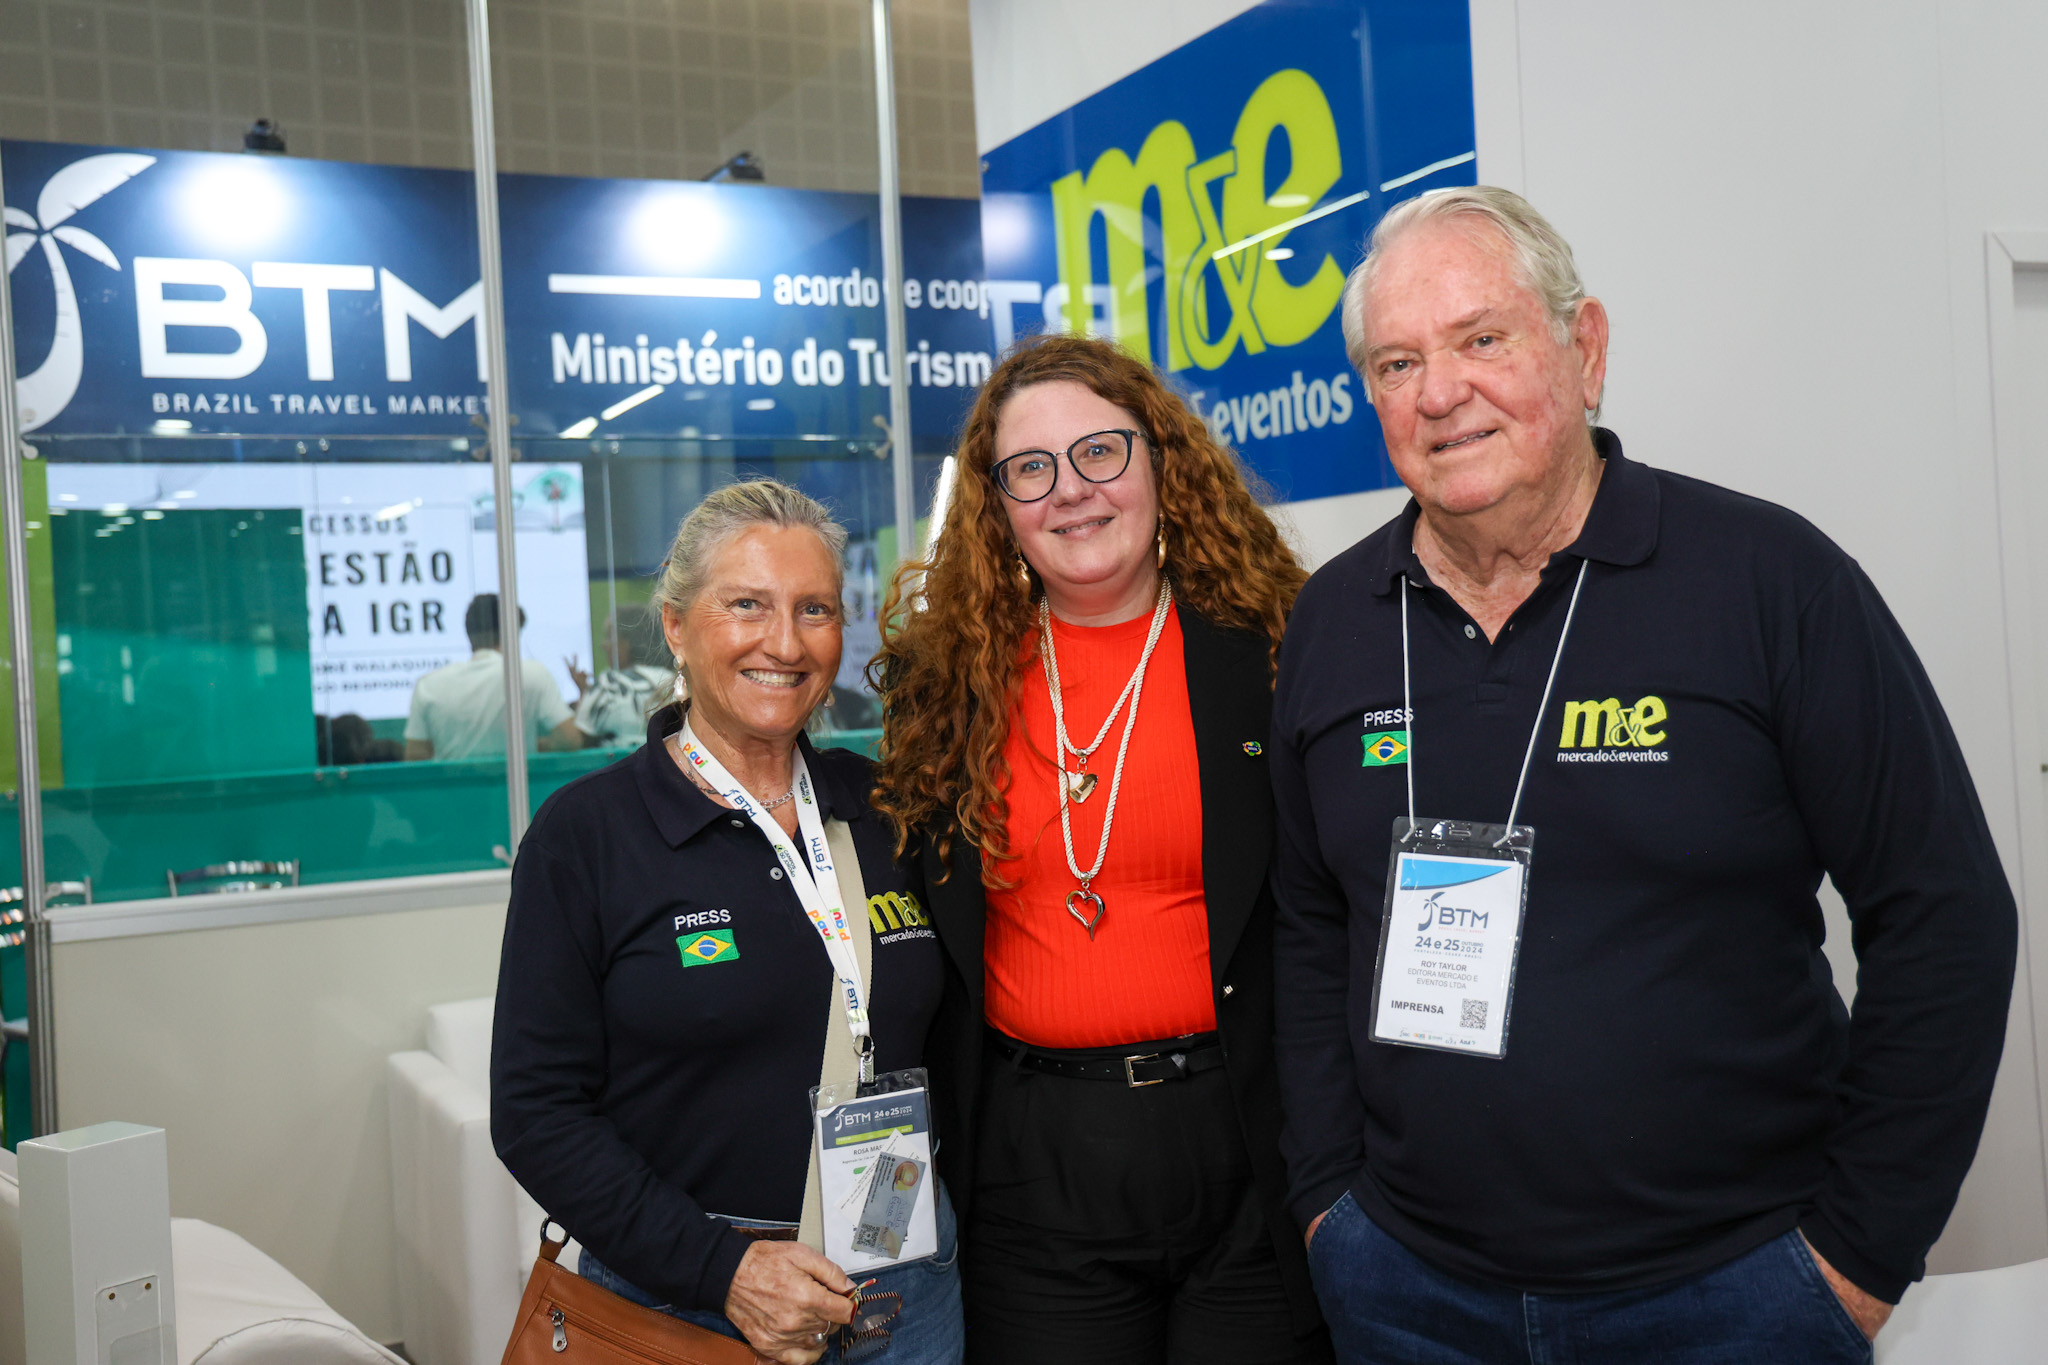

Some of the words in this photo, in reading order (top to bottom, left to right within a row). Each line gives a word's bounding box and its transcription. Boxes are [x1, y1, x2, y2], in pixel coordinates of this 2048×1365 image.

[773, 268, 880, 307] acordo
[133, 257, 489, 382] BTM
[551, 330, 784, 387] Ministério
[791, 337, 845, 387] do
[153, 392, 259, 414] BRAZIL
[270, 394, 378, 415] TRAVEL
[320, 541, 453, 586] ESTÃO
[371, 601, 444, 636] IGR
[1363, 707, 1414, 727] PRESS
[1558, 695, 1668, 749] m&e
[734, 794, 757, 818] BTM
[811, 837, 825, 863] BTM
[674, 909, 732, 931] PRESS
[1438, 907, 1489, 929] BTM
[1415, 936, 1431, 948] 24
[1434, 940, 1442, 949] e
[1443, 939, 1460, 951] 25
[1460, 946, 1482, 954] 2024
[1407, 968, 1437, 978] EDITORA
[1437, 971, 1472, 981] MERCADO
[1421, 960, 1437, 969] ROY
[1438, 962, 1467, 972] TAYLOR
[1416, 978, 1448, 988] EVENTOS
[1449, 981, 1467, 990] LTDA
[1391, 1000, 1444, 1015] IMPRENSA
[845, 1112, 871, 1126] BTM
[874, 1111, 884, 1119] 24
[890, 1107, 900, 1116] 25
[853, 1148, 869, 1156] ROSA
